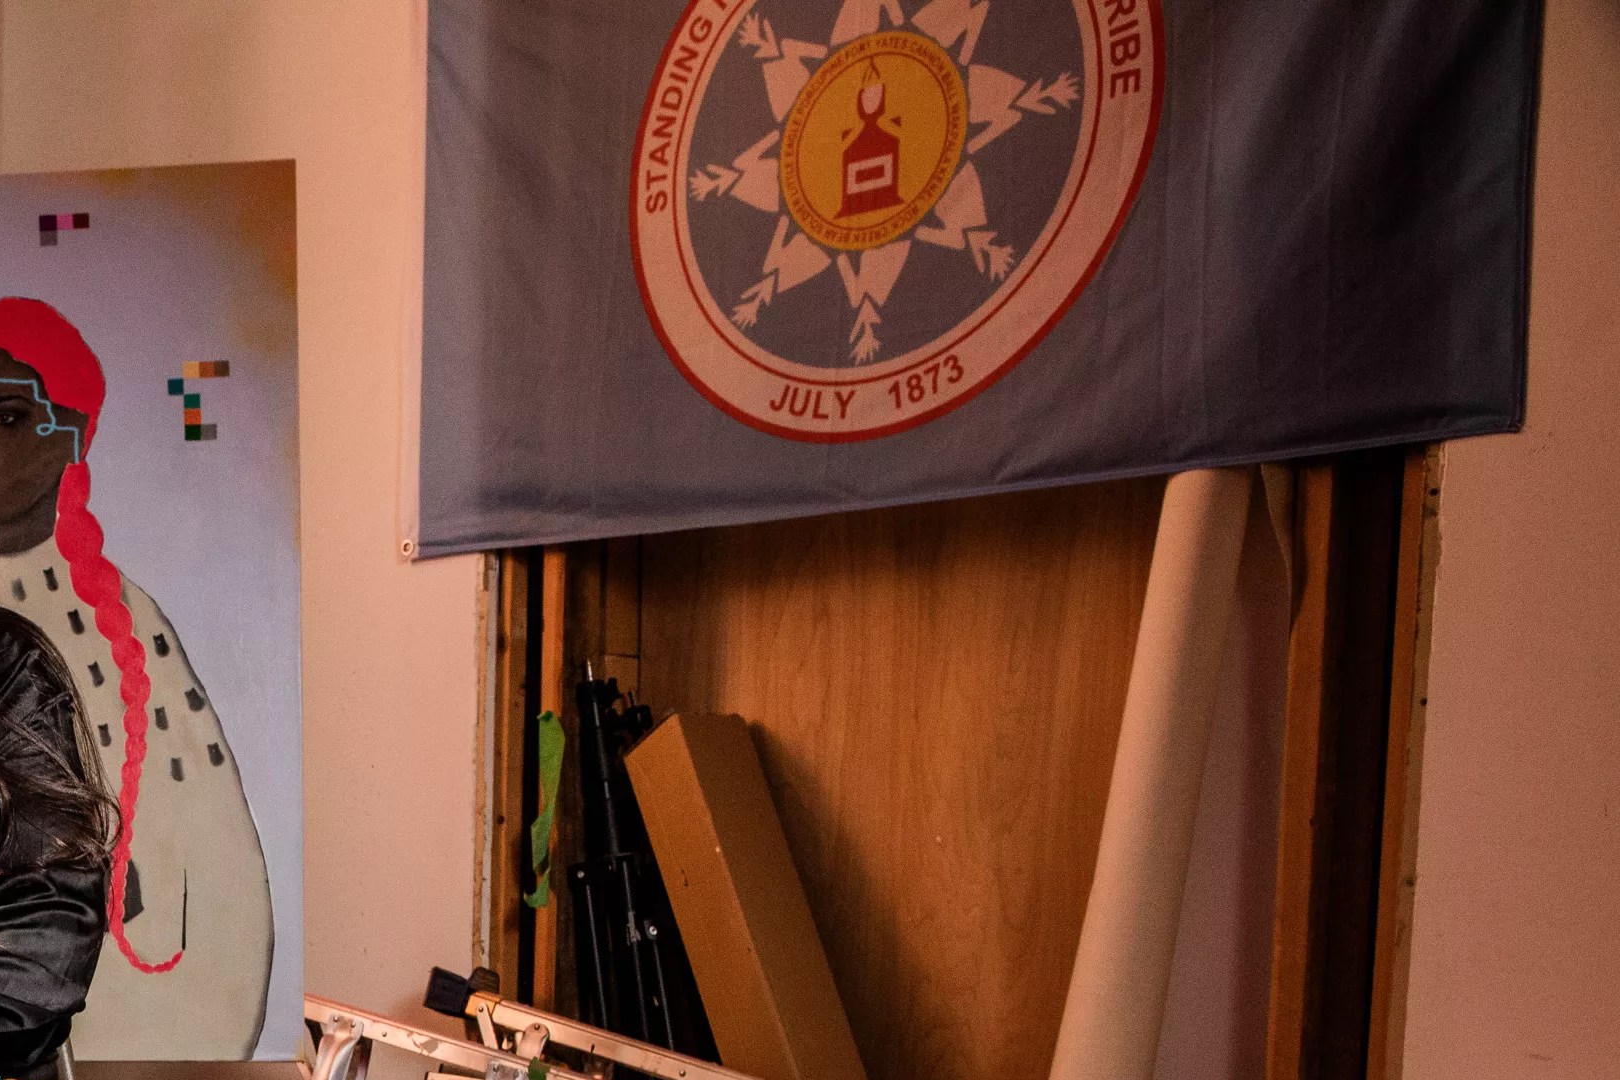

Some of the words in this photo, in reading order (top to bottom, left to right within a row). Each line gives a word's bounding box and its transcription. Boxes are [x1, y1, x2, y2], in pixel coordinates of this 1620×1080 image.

[645, 15, 713, 214] STANDING
[1104, 0, 1141, 99] RIBE
[770, 384, 856, 420] JULY
[888, 354, 964, 409] 1873
